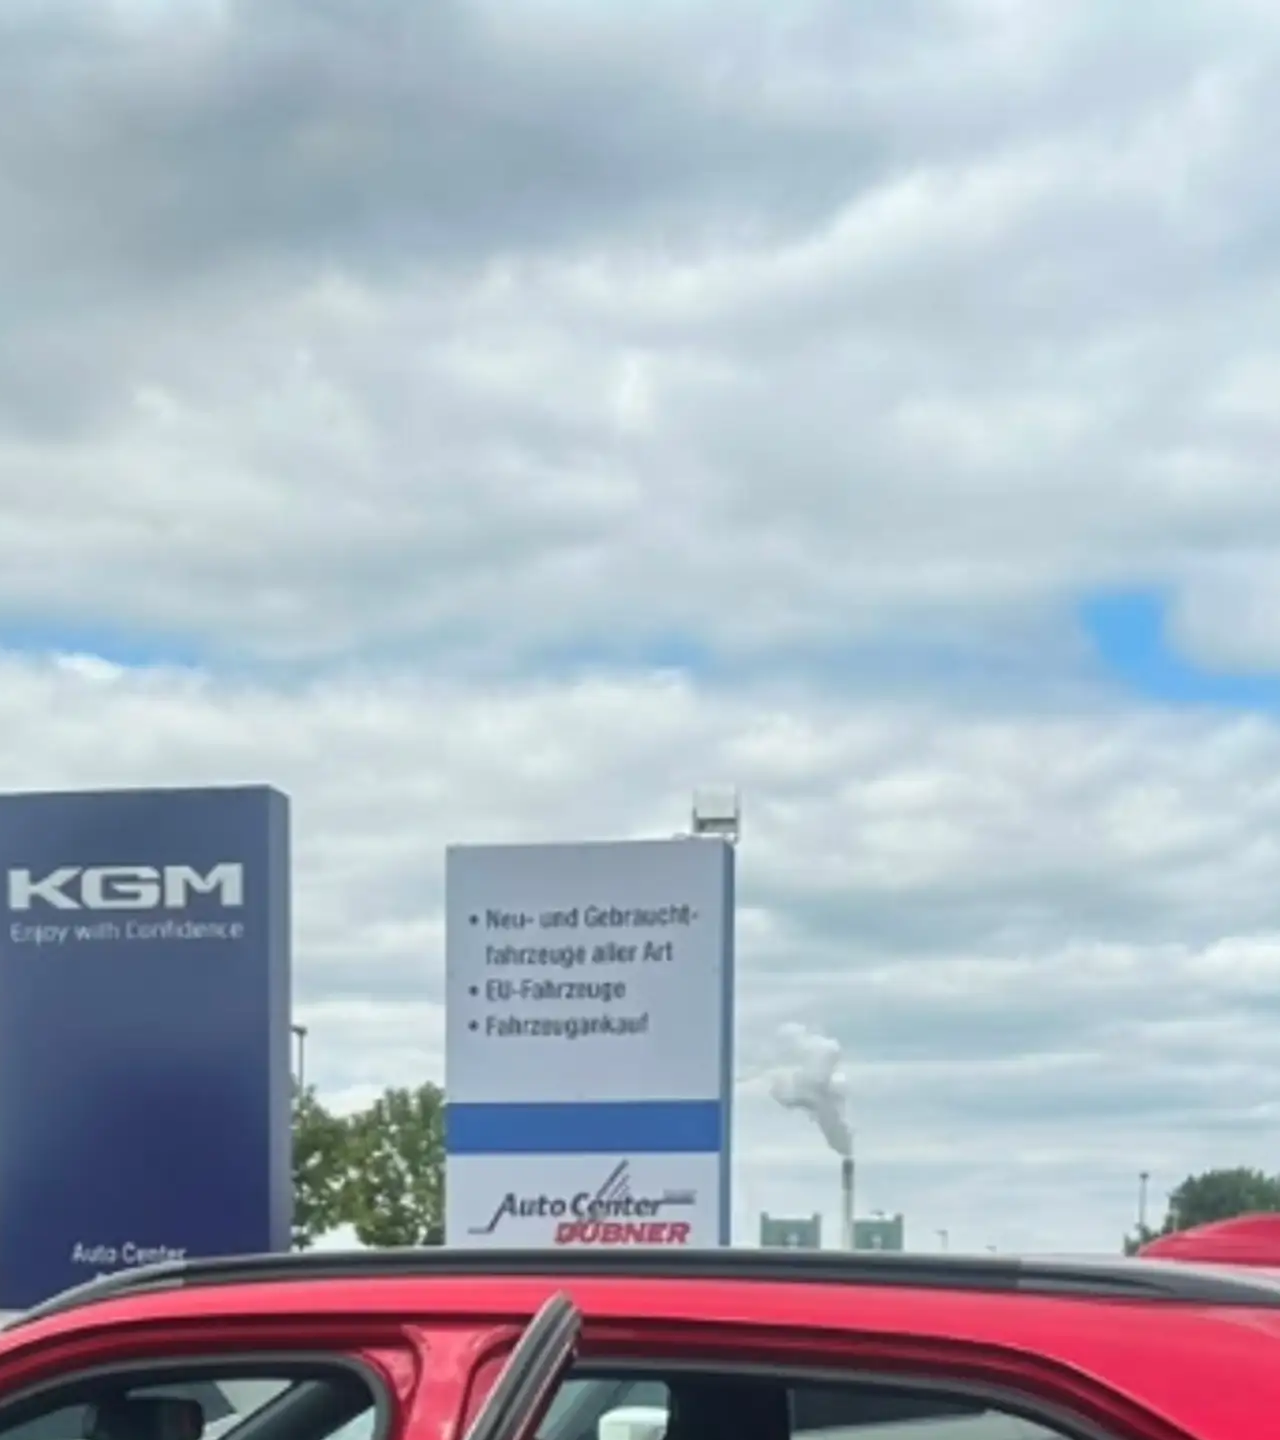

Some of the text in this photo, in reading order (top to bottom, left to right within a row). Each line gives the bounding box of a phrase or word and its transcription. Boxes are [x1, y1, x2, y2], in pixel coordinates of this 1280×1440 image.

[8, 862, 245, 911] KGM
[485, 904, 699, 930] Neu- und Gebraucht-
[9, 919, 245, 946] Enjoy with Confidence
[485, 940, 674, 969] fahrzeuge aller Art
[485, 978, 626, 1002] EU-Fahrzeuge
[485, 1012, 649, 1039] Fahrzeugankauf
[499, 1192, 567, 1217] Auto
[570, 1192, 662, 1218] Center
[73, 1241, 117, 1263] Auto
